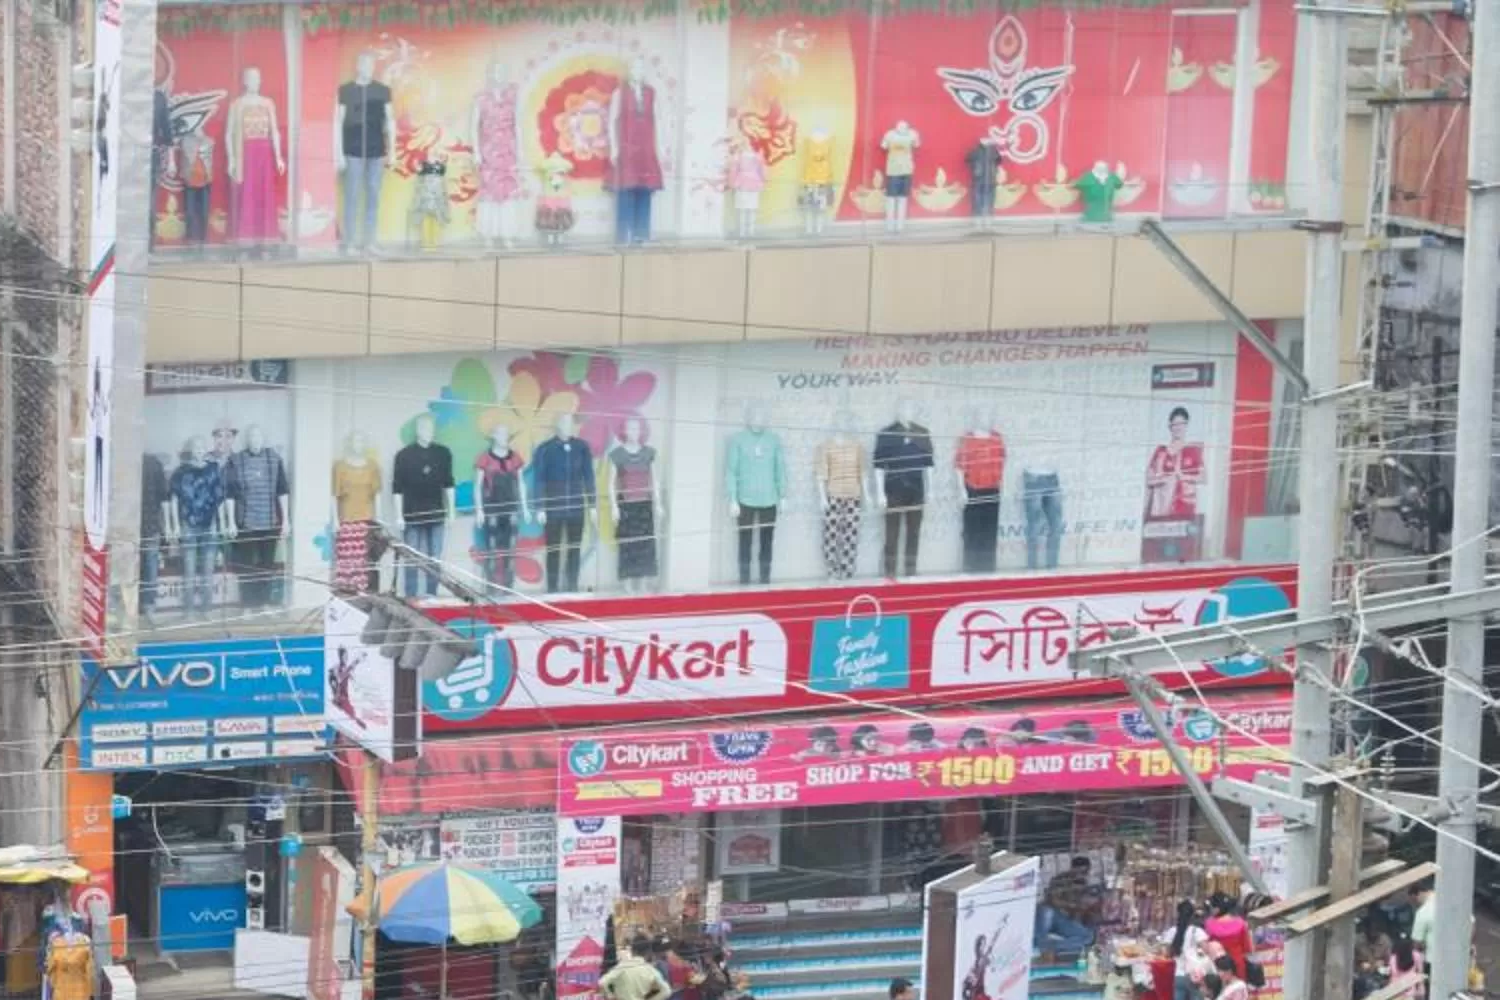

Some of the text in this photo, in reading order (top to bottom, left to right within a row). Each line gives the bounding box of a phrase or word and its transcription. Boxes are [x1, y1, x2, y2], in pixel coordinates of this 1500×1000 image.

[841, 350, 932, 370] MAKING
[938, 345, 1047, 367] CHANGES
[229, 667, 268, 680] Smart
[273, 665, 313, 679] Phone
[536, 629, 755, 697] Citykart
[611, 743, 689, 769] Citykart
[805, 766, 864, 785] SHOP
[869, 762, 912, 783] FOR
[1021, 756, 1062, 775] AND
[1070, 751, 1114, 772] GET
[671, 767, 757, 787] SHOPPING
[691, 781, 800, 807] FREE
